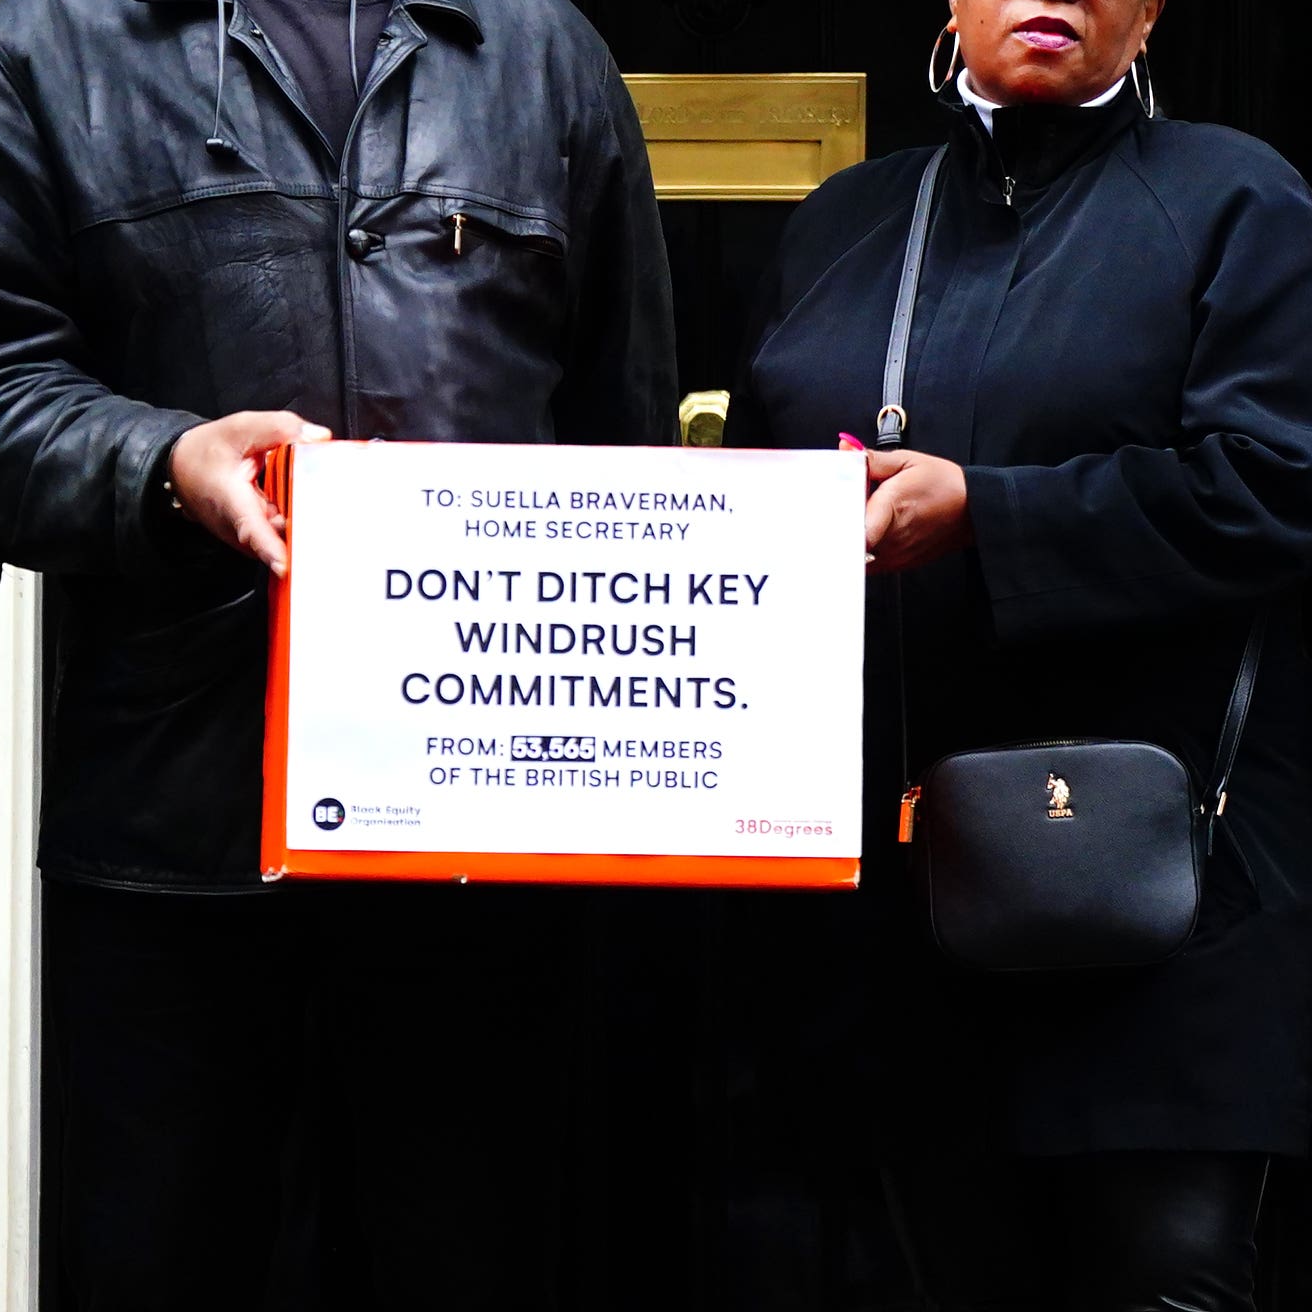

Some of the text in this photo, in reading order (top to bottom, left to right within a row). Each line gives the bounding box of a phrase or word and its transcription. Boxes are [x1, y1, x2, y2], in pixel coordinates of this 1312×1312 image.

[421, 489, 733, 513] TO: SUELLA BRAVERMAN,
[465, 519, 690, 541] HOME SECRETARY
[385, 568, 769, 606] DON'T DITCH KEY
[453, 621, 696, 657] WINDRUSH
[400, 672, 748, 710] COMMITMENTS.
[426, 736, 723, 762] FROM: 53,565 MEMBERS
[429, 766, 718, 789] OF THE BRITISH PUBLIC
[350, 804, 421, 816] Black Equity
